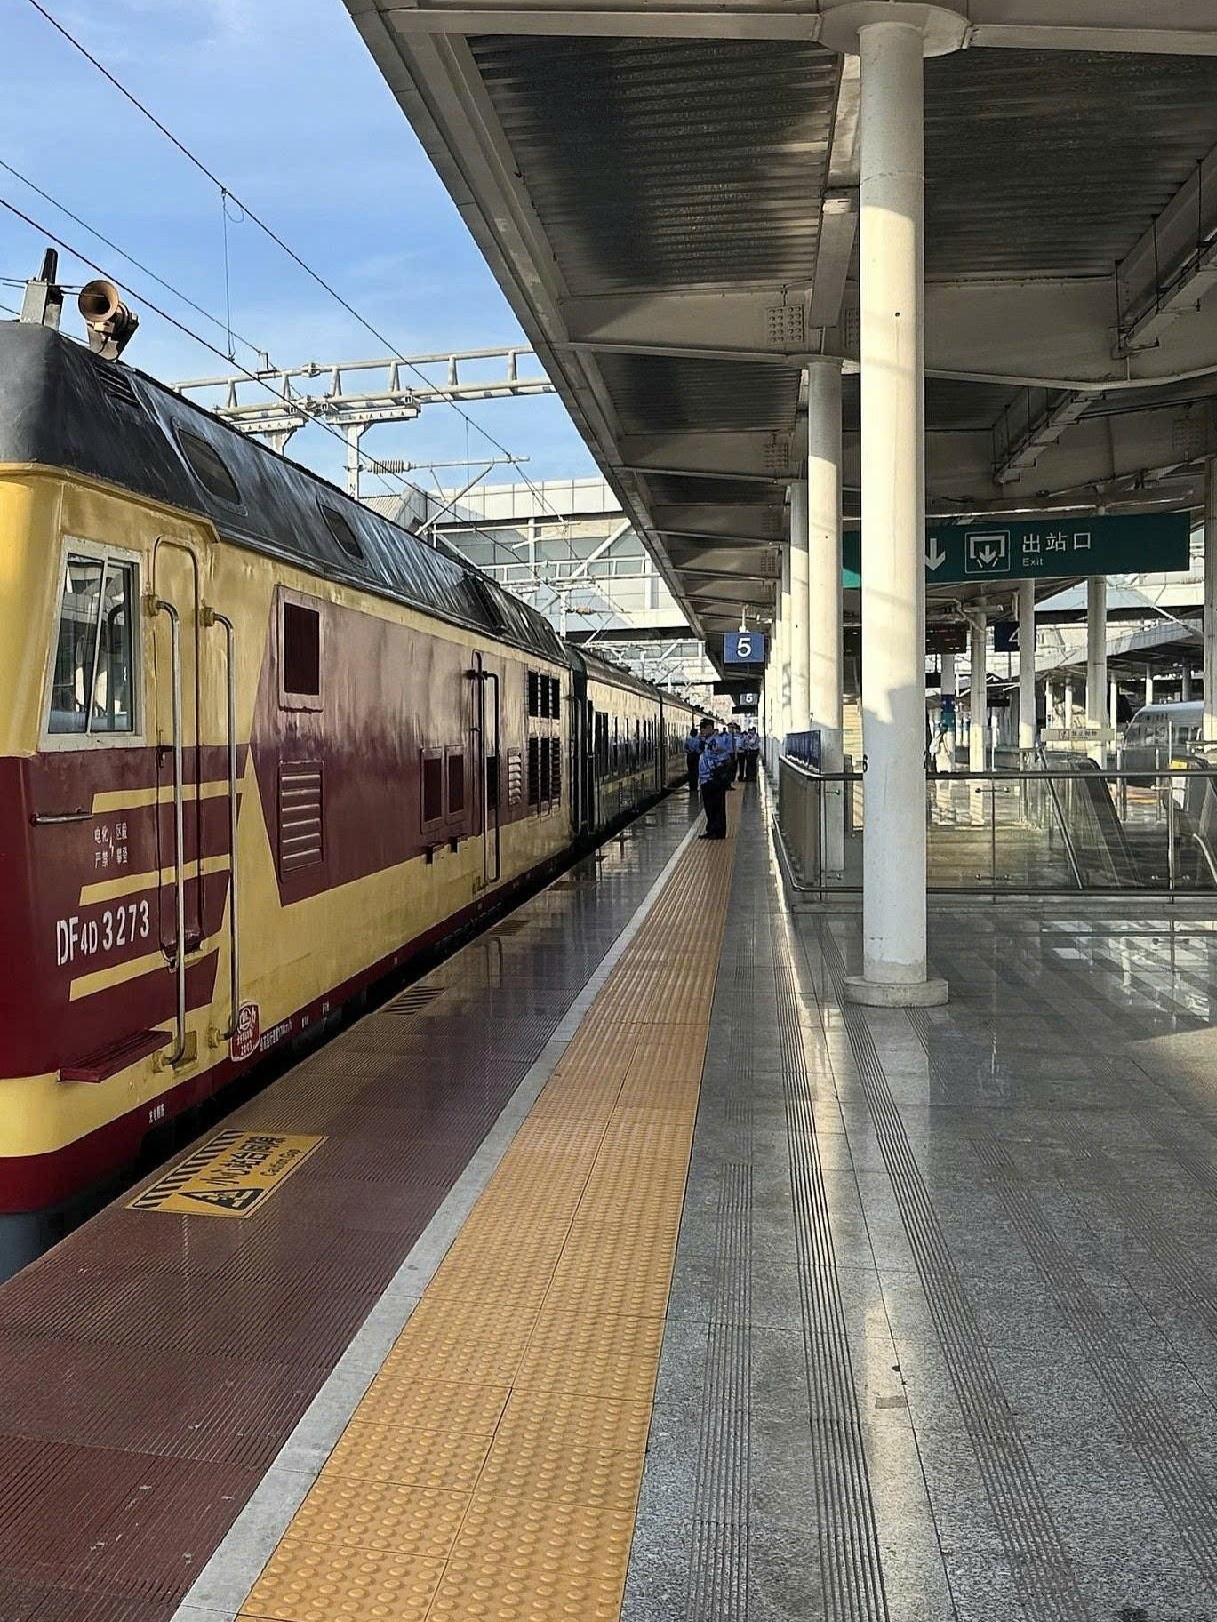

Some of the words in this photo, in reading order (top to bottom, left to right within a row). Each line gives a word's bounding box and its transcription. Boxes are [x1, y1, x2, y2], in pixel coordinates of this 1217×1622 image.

[1022, 532, 1092, 554] 出站口
[1022, 557, 1044, 567] Exit
[737, 637, 752, 658] 5
